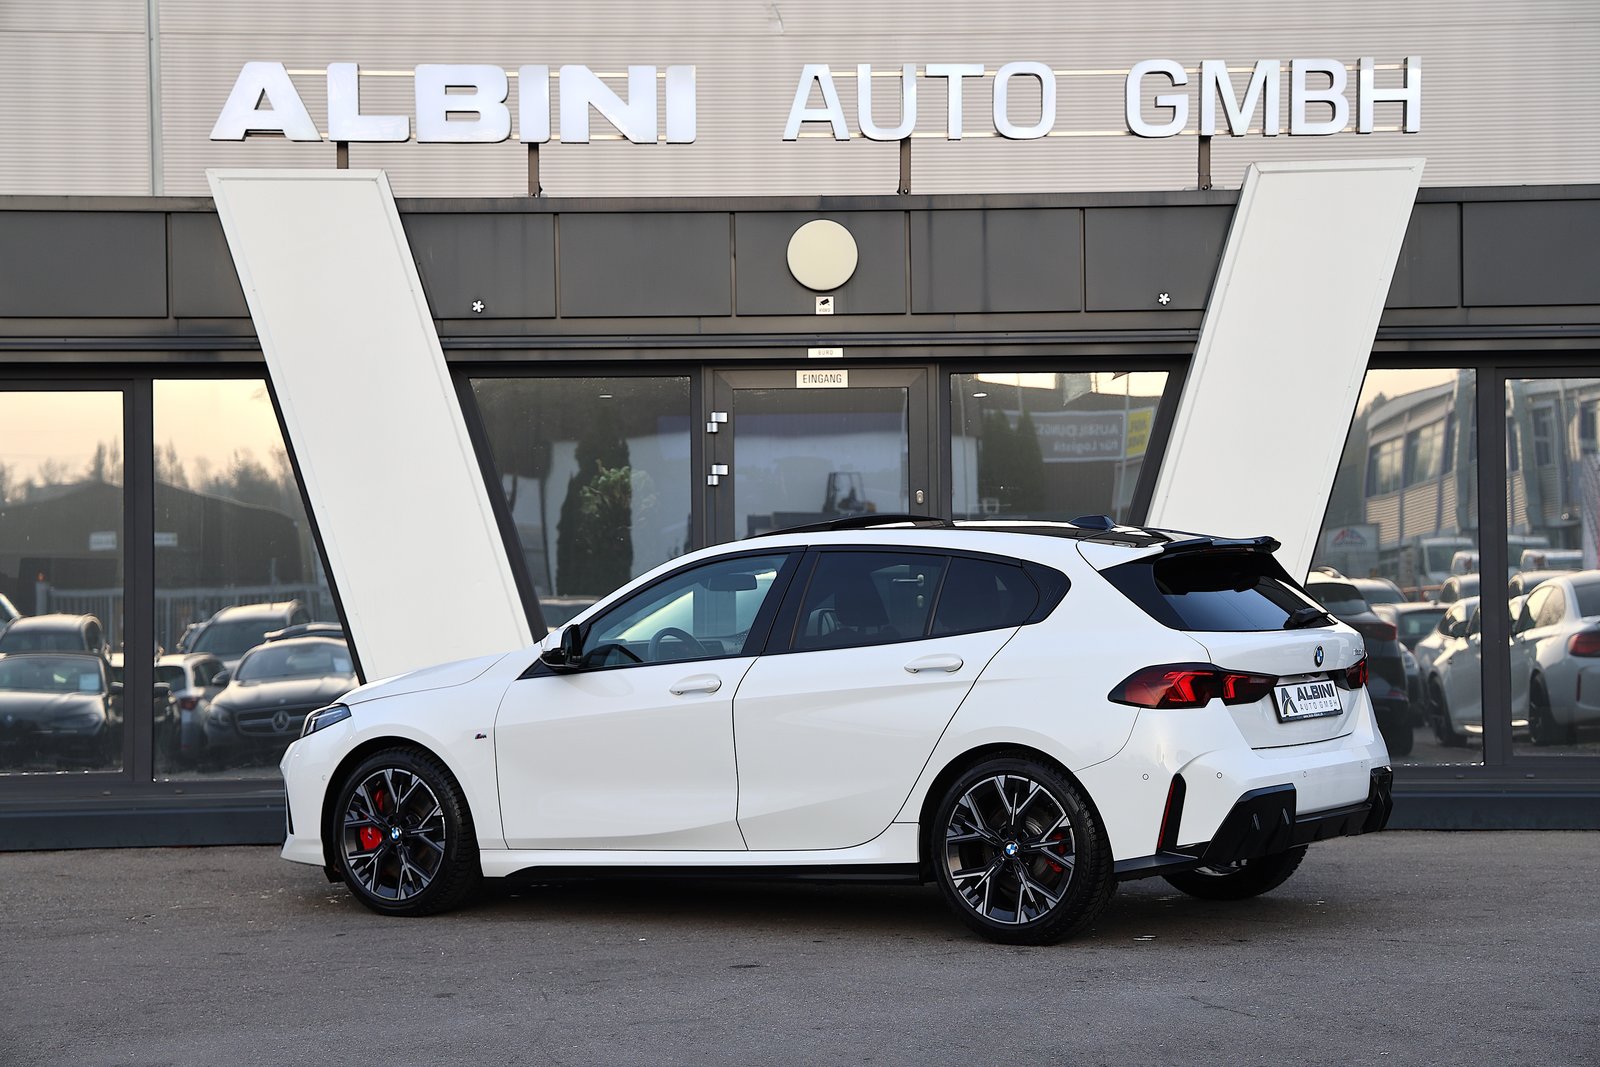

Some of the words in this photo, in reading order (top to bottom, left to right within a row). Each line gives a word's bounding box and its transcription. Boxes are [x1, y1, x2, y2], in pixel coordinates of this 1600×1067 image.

[210, 61, 697, 144] ALBINI
[782, 61, 1057, 141] AUTO
[1125, 55, 1422, 137] GMBH
[802, 373, 842, 384] EINGANG
[1296, 683, 1335, 701] ALBINI
[1299, 701, 1318, 711] AUTO
[1319, 700, 1339, 709] GMBH
